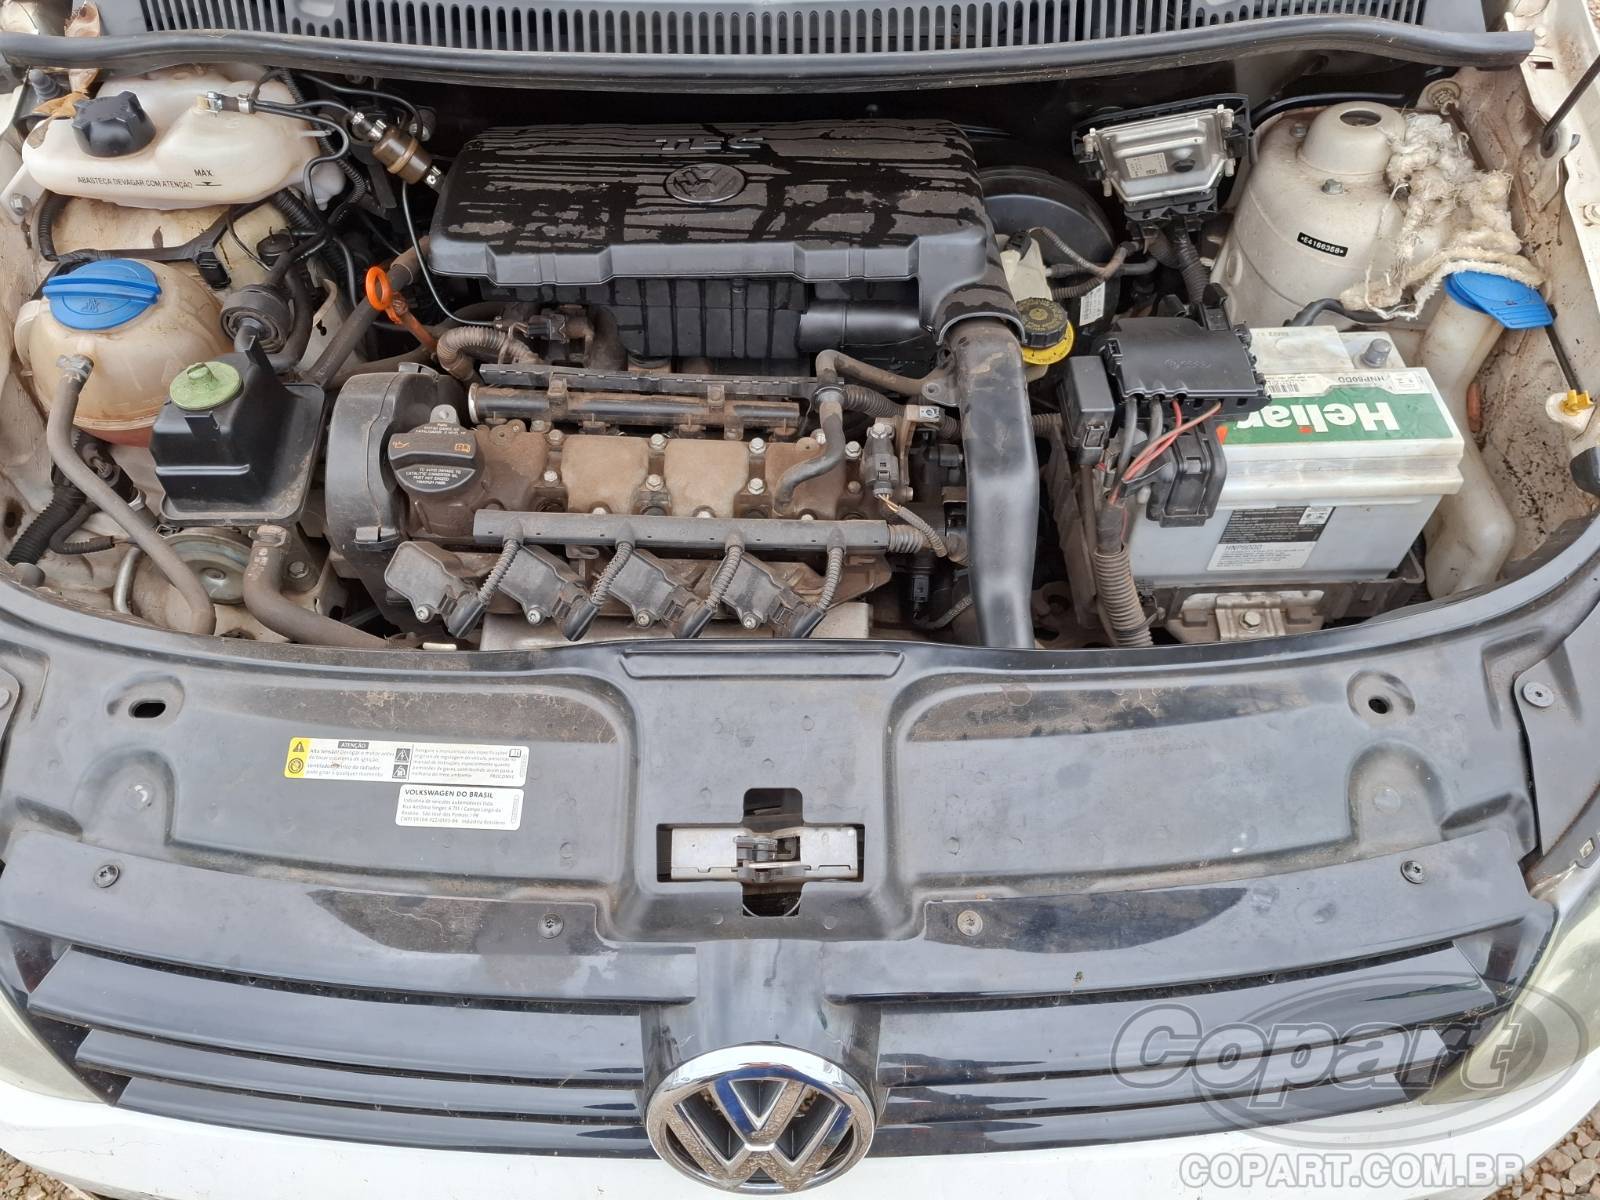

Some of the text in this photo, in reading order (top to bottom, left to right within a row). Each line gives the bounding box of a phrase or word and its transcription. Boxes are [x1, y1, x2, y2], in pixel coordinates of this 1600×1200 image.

[145, 179, 161, 188] COM
[1236, 401, 1400, 433] Heliar
[340, 741, 367, 749] ATENÇÃO
[404, 789, 455, 797] VOLKSWAGEN
